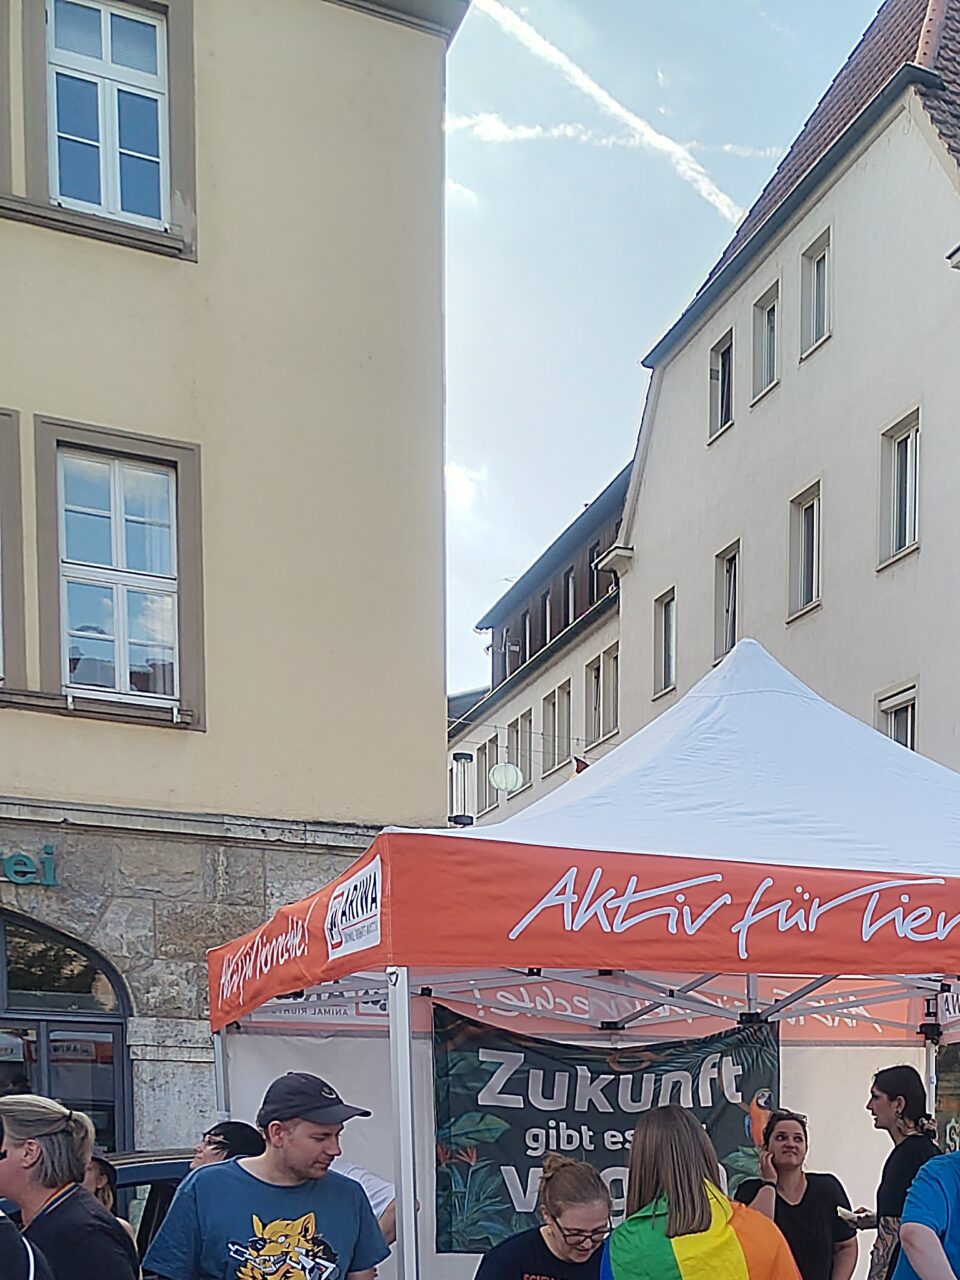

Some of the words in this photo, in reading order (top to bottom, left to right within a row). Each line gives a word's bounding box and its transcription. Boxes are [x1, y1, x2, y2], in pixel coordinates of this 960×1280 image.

[0, 845, 59, 886] ei
[340, 871, 378, 925] ARIWA
[508, 866, 732, 940] Aktiv
[731, 877, 850, 960] für
[477, 1048, 744, 1114] Zukunft
[525, 1119, 595, 1157] gibt
